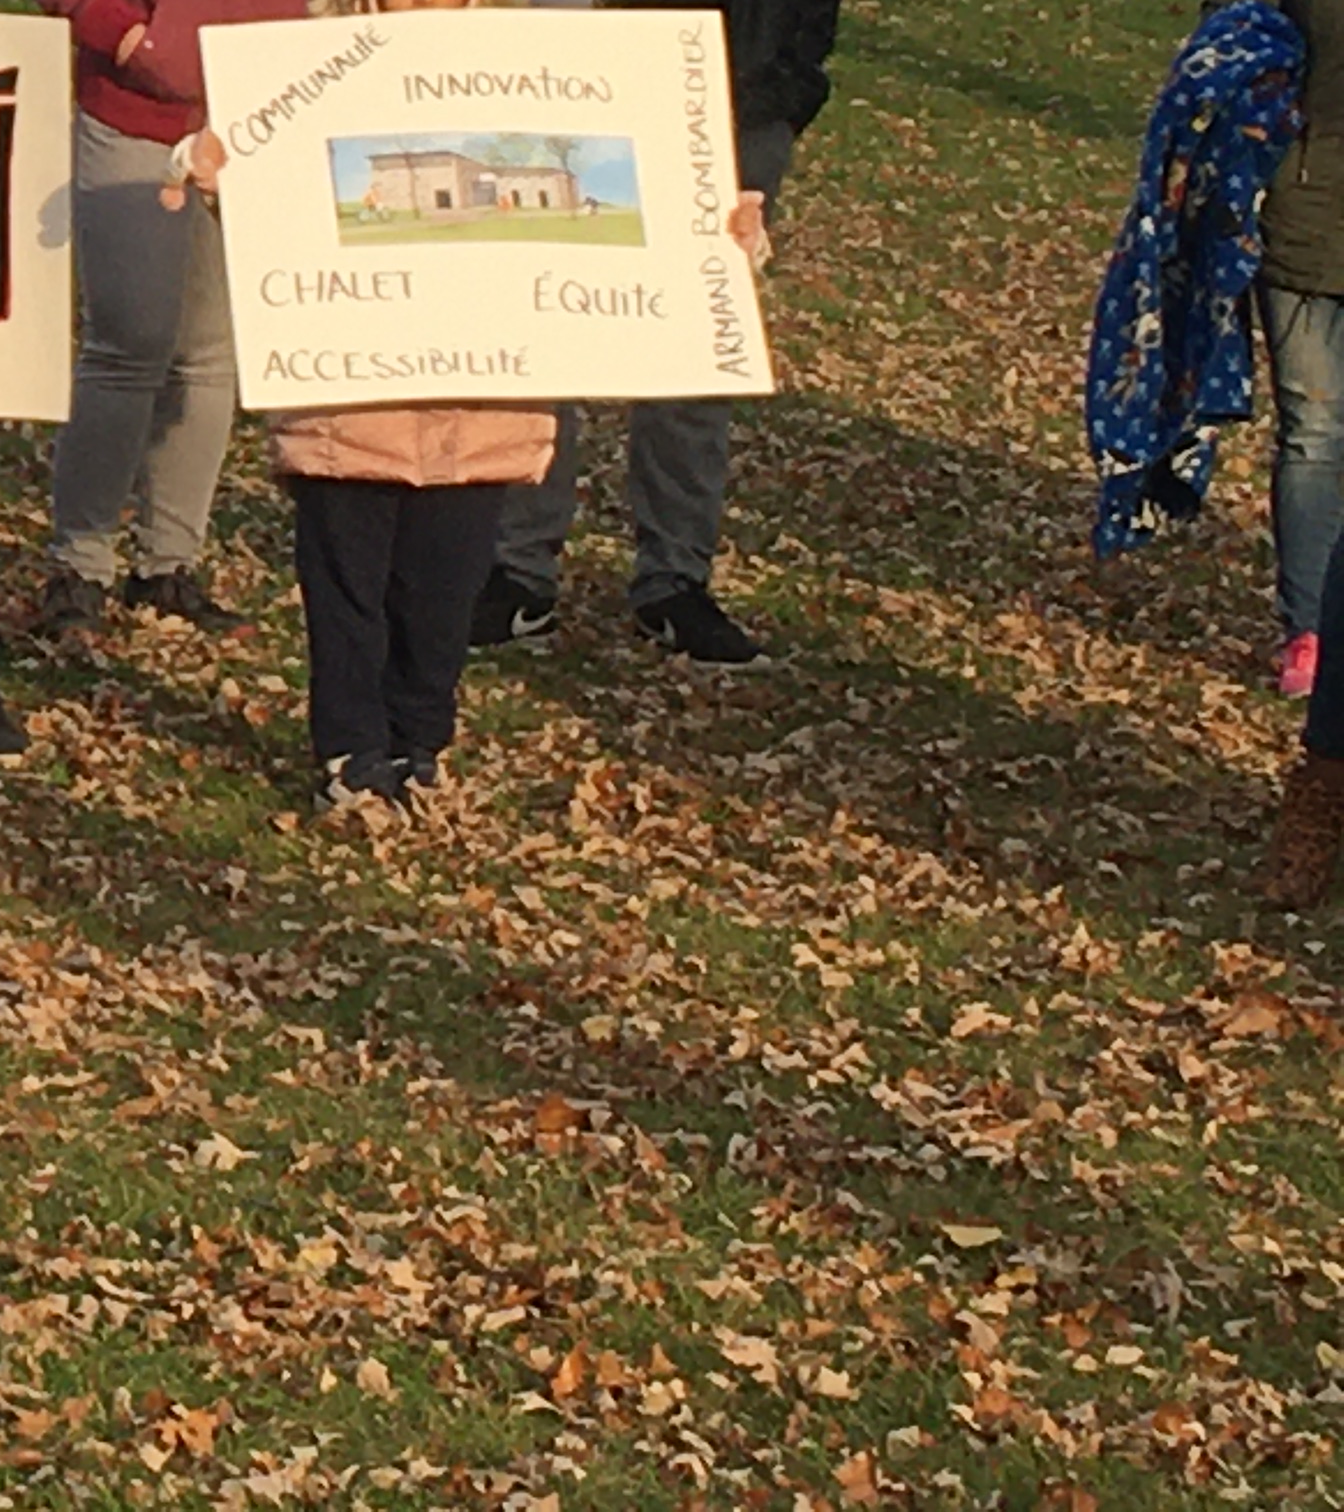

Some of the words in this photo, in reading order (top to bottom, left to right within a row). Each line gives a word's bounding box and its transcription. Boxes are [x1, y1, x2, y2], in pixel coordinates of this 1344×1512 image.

[678, 20, 721, 237] BOMBARDIER
[260, 269, 413, 307] CHALET
[704, 258, 752, 378] ARMAND
